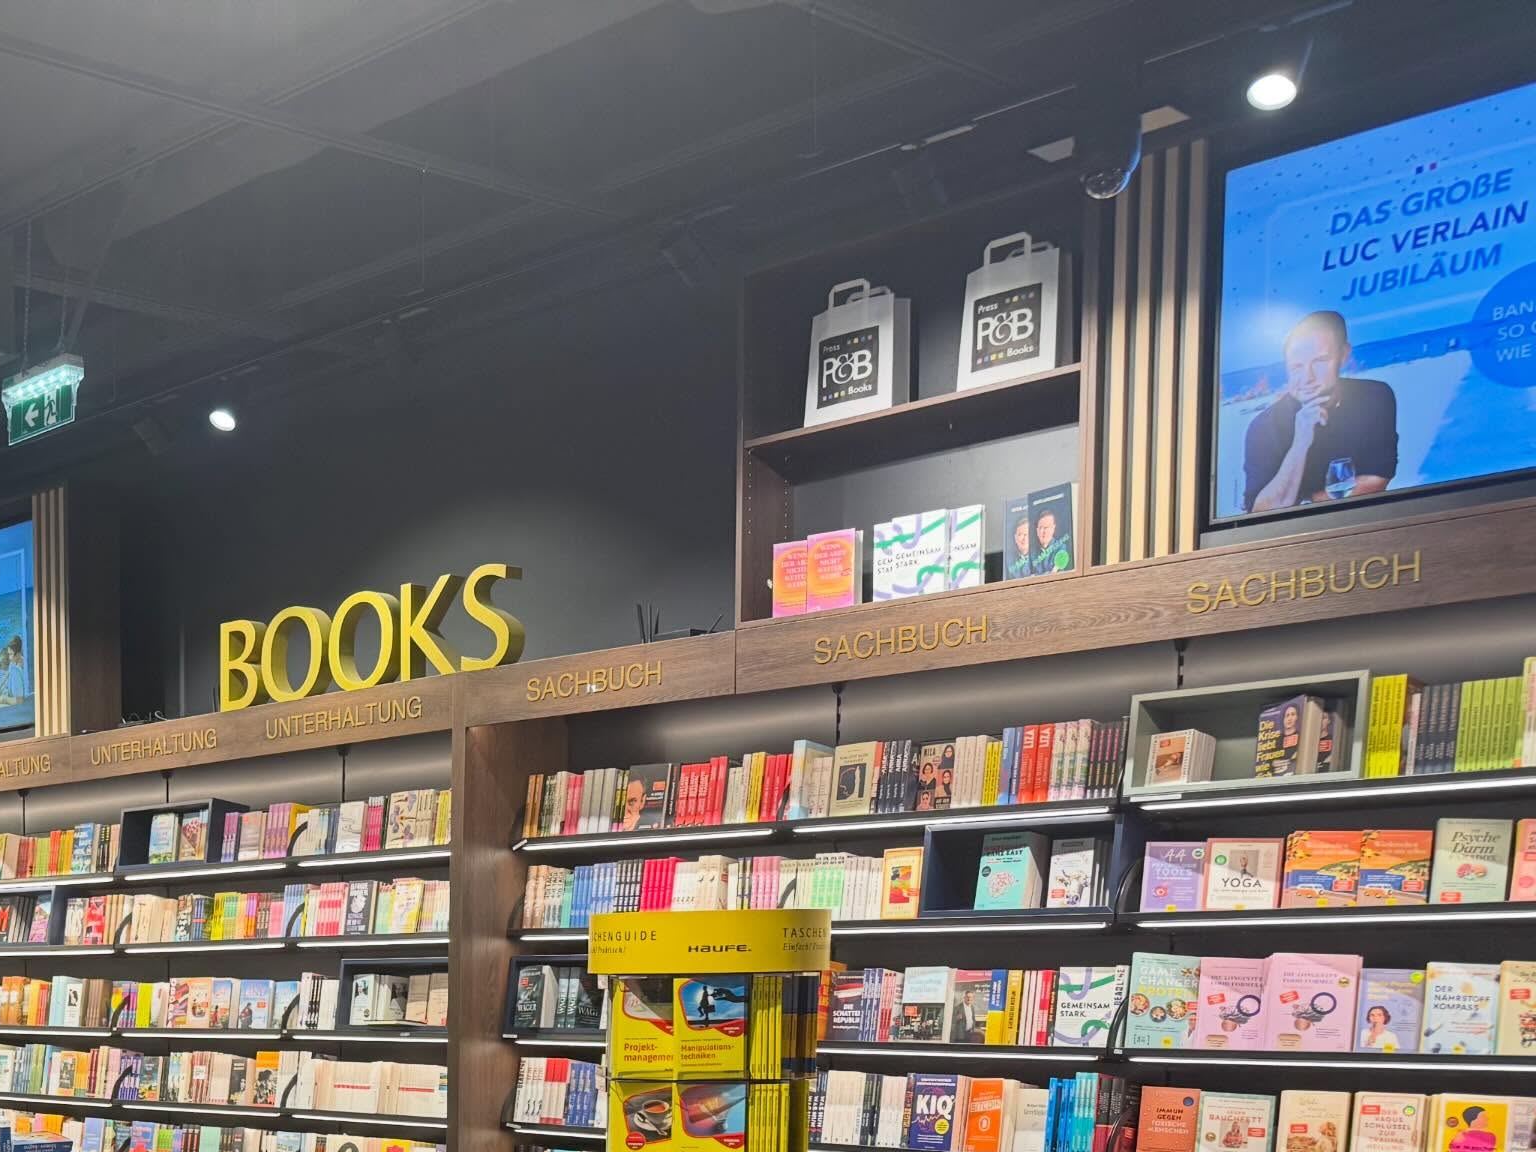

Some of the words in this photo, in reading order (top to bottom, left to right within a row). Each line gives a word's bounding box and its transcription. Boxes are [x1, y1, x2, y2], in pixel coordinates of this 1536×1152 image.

[1330, 205, 1391, 236] DAS
[1321, 239, 1380, 271] LUC
[1392, 201, 1529, 255] VERLAIN
[1341, 243, 1503, 302] JUBILÄUM
[977, 302, 998, 314] Press
[976, 307, 1035, 351] P&B
[1497, 324, 1525, 341] SO
[822, 344, 841, 353] Press
[1006, 343, 1034, 357] Books
[1496, 343, 1533, 362] WIE
[821, 349, 873, 389] P&B
[847, 383, 873, 395] Books
[895, 547, 942, 560] GEMEINSAM
[1184, 550, 1423, 614] SACHBUCH
[219, 563, 526, 713] BOOKS
[812, 614, 989, 665] SACHBUCH
[525, 660, 663, 703] SACHBUCH
[265, 696, 423, 739] UNTERHALTUNG
[1258, 720, 1275, 731] Die
[1257, 730, 1282, 741] Krise
[90, 727, 218, 767] UNTERHALTUNG
[1257, 739, 1277, 751] liebt
[1256, 749, 1286, 762] Frauen
[1450, 831, 1502, 844] Psyche
[1451, 842, 1496, 854] Darm
[1154, 868, 1193, 877] TOOLS
[1220, 877, 1263, 889] YOGA
[1140, 966, 1177, 977] GAME
[1139, 975, 1200, 988] CHANGER
[1434, 985, 1454, 993] DER
[1060, 1001, 1111, 1010] GEMEINSAM
[1433, 1002, 1480, 1012] KOMPASS
[624, 1042, 659, 1054] Projekt-
[681, 1043, 735, 1053] Manipulations-
[681, 1052, 716, 1061] techniken
[915, 1093, 954, 1120] KIQ
[1156, 1107, 1185, 1115] IMMUN
[1208, 1113, 1264, 1124] BAUCHFETT
